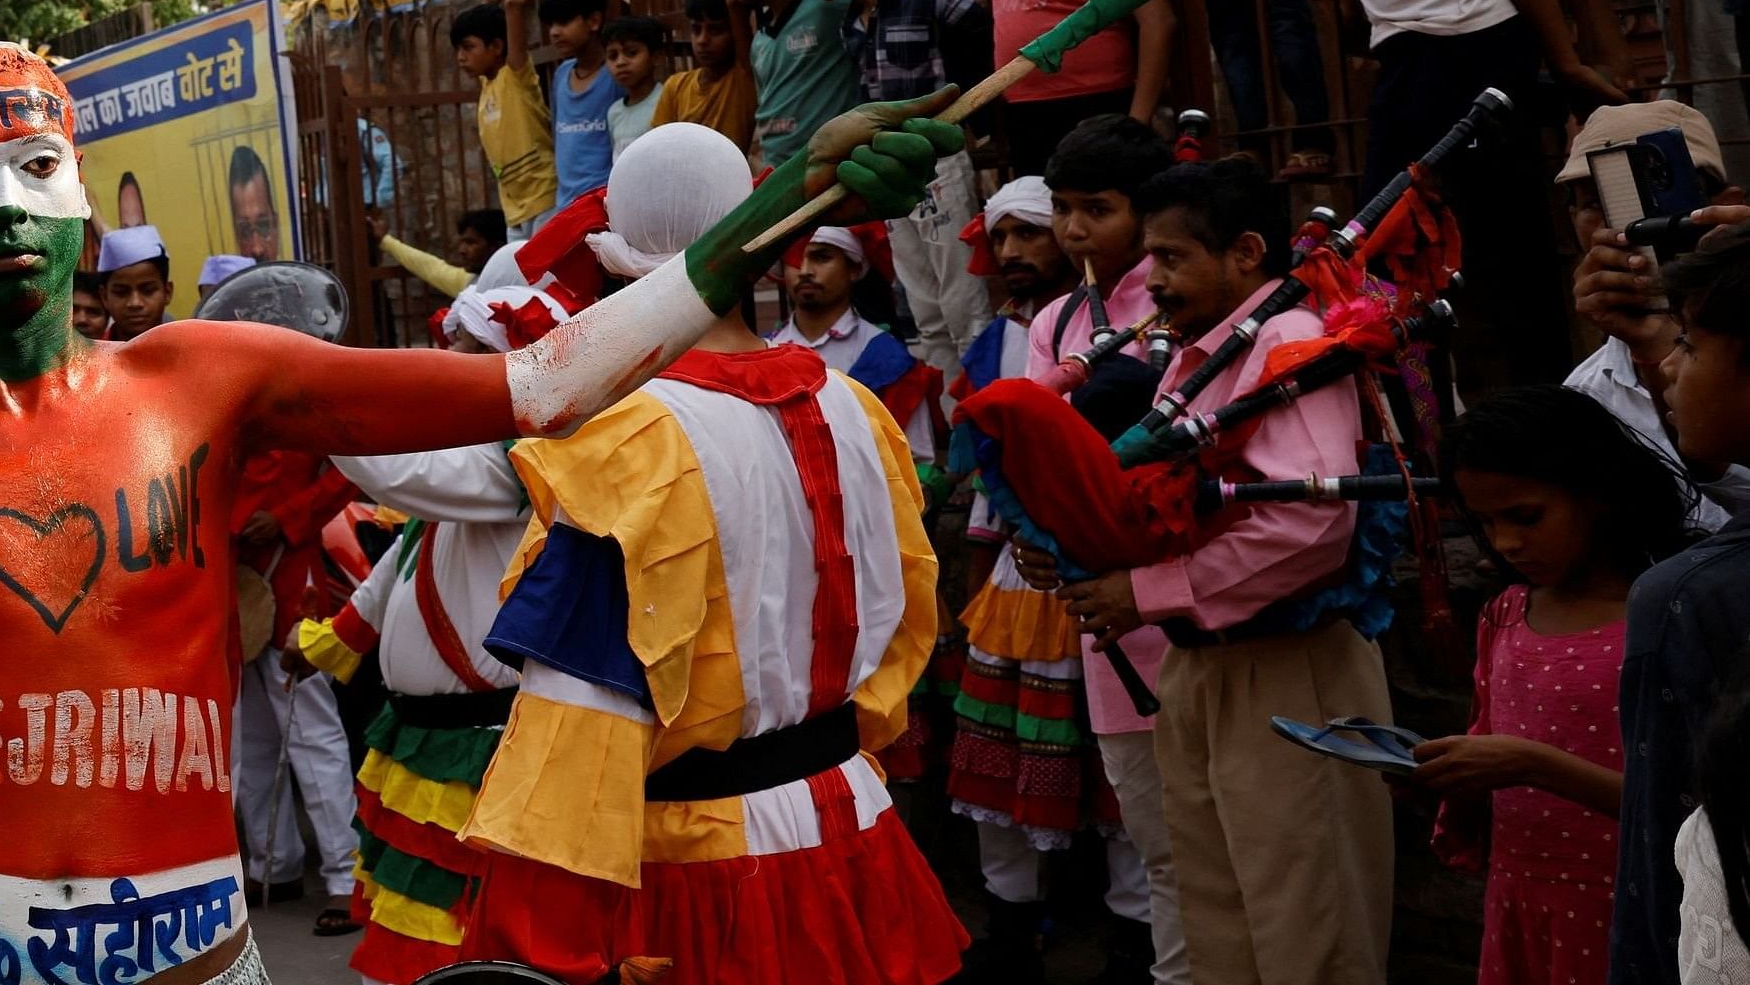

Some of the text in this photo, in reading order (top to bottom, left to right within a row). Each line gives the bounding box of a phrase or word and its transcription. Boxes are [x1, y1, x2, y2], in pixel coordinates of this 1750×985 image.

[95, 88, 123, 125] का
[122, 71, 176, 118] जवाब
[176, 52, 214, 102] वोट
[217, 38, 245, 92] से
[114, 442, 210, 573] LOVE
[26, 877, 240, 985] सहीराम
